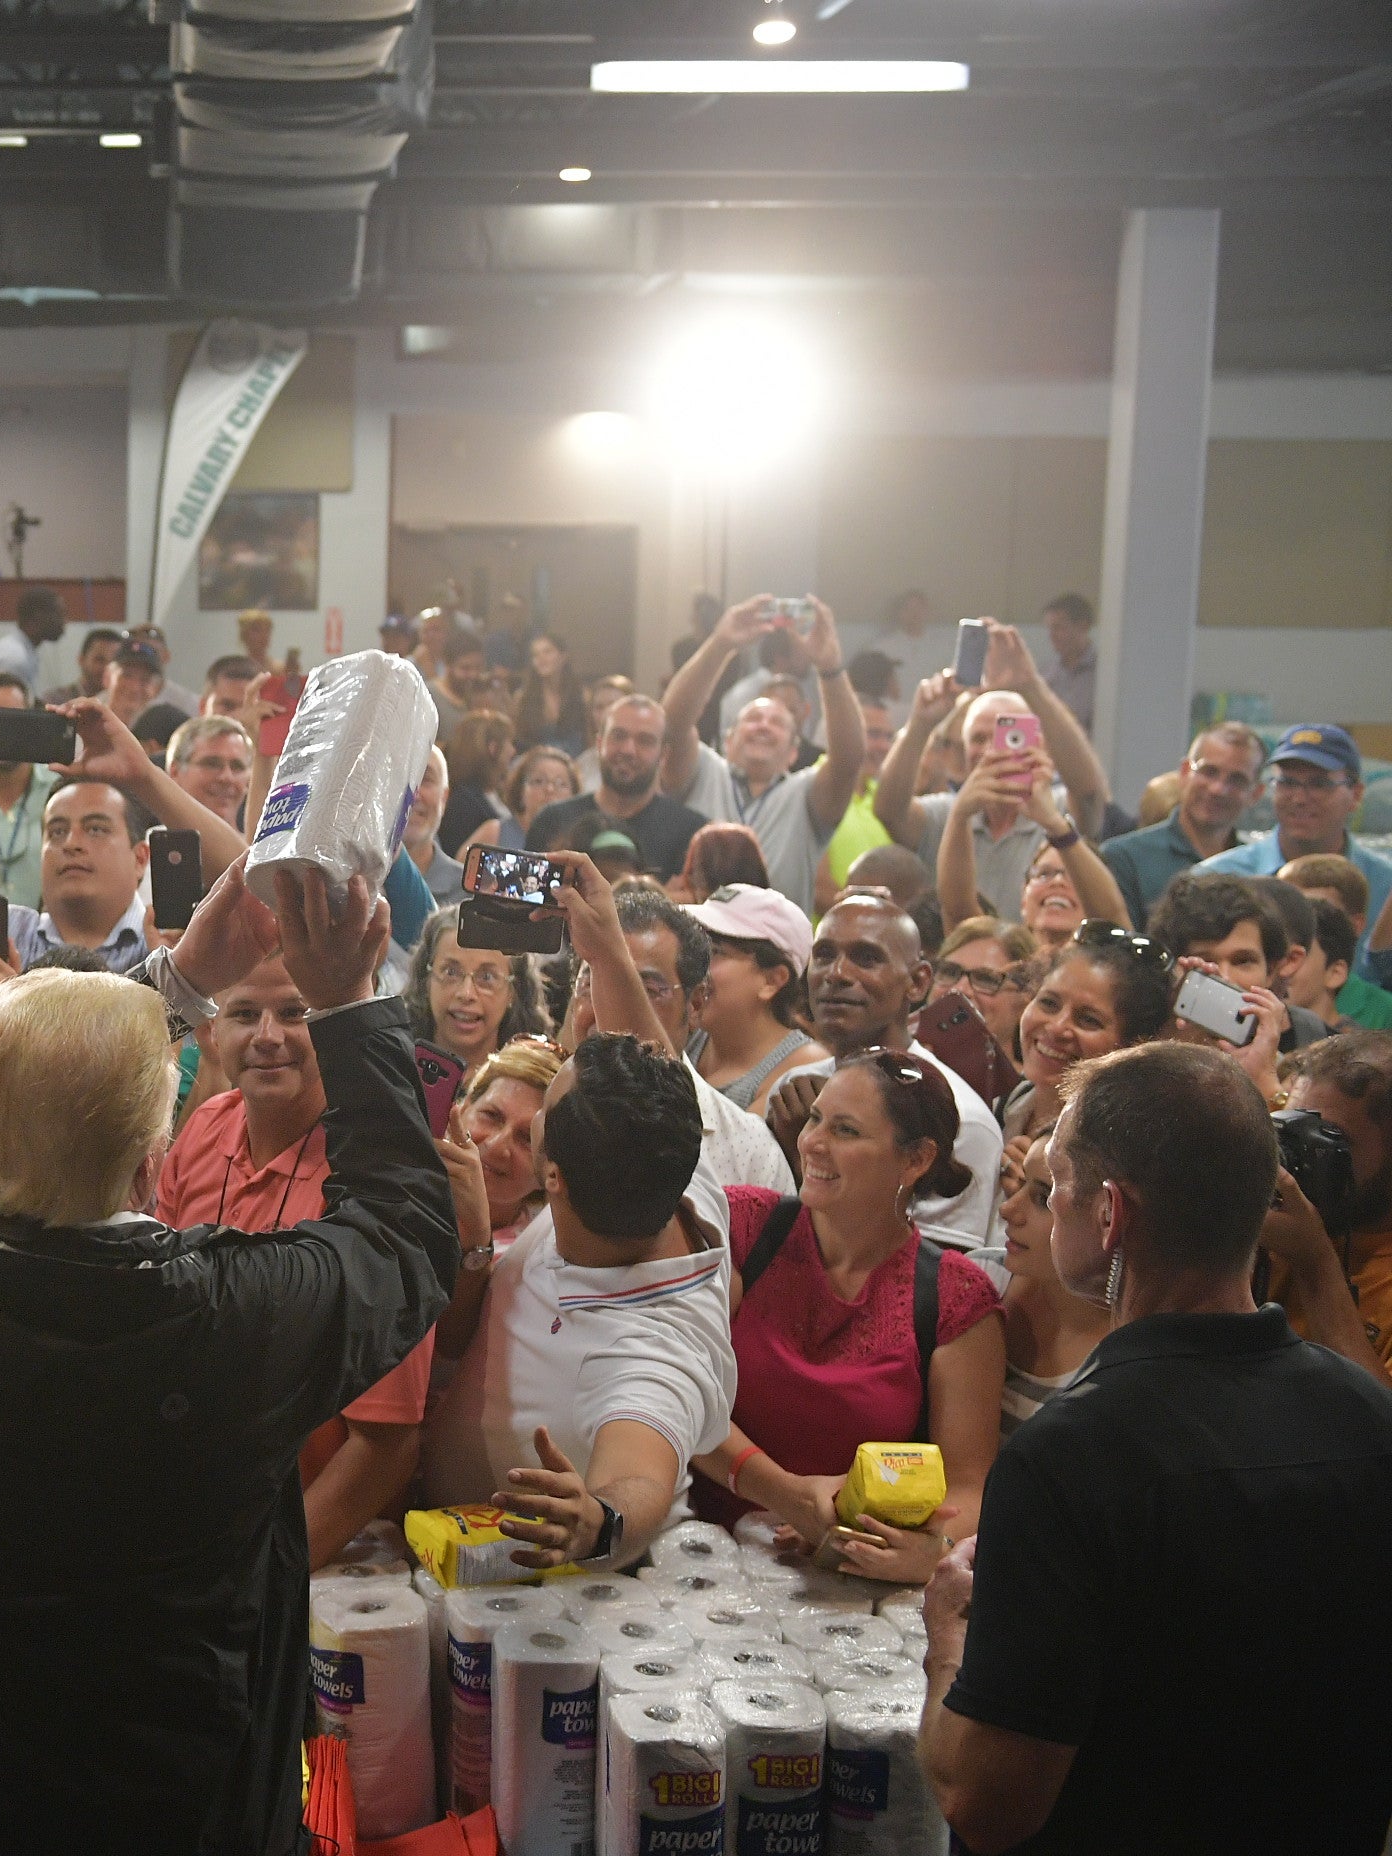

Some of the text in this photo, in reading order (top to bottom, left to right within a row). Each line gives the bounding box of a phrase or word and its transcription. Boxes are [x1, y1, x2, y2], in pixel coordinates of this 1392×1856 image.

[168, 427, 239, 539] CALVARY
[313, 1671, 354, 1699] towels
[752, 1756, 767, 1786] 1
[652, 1775, 668, 1804] 1
[747, 1811, 820, 1833] paper
[649, 1828, 722, 1852] paper
